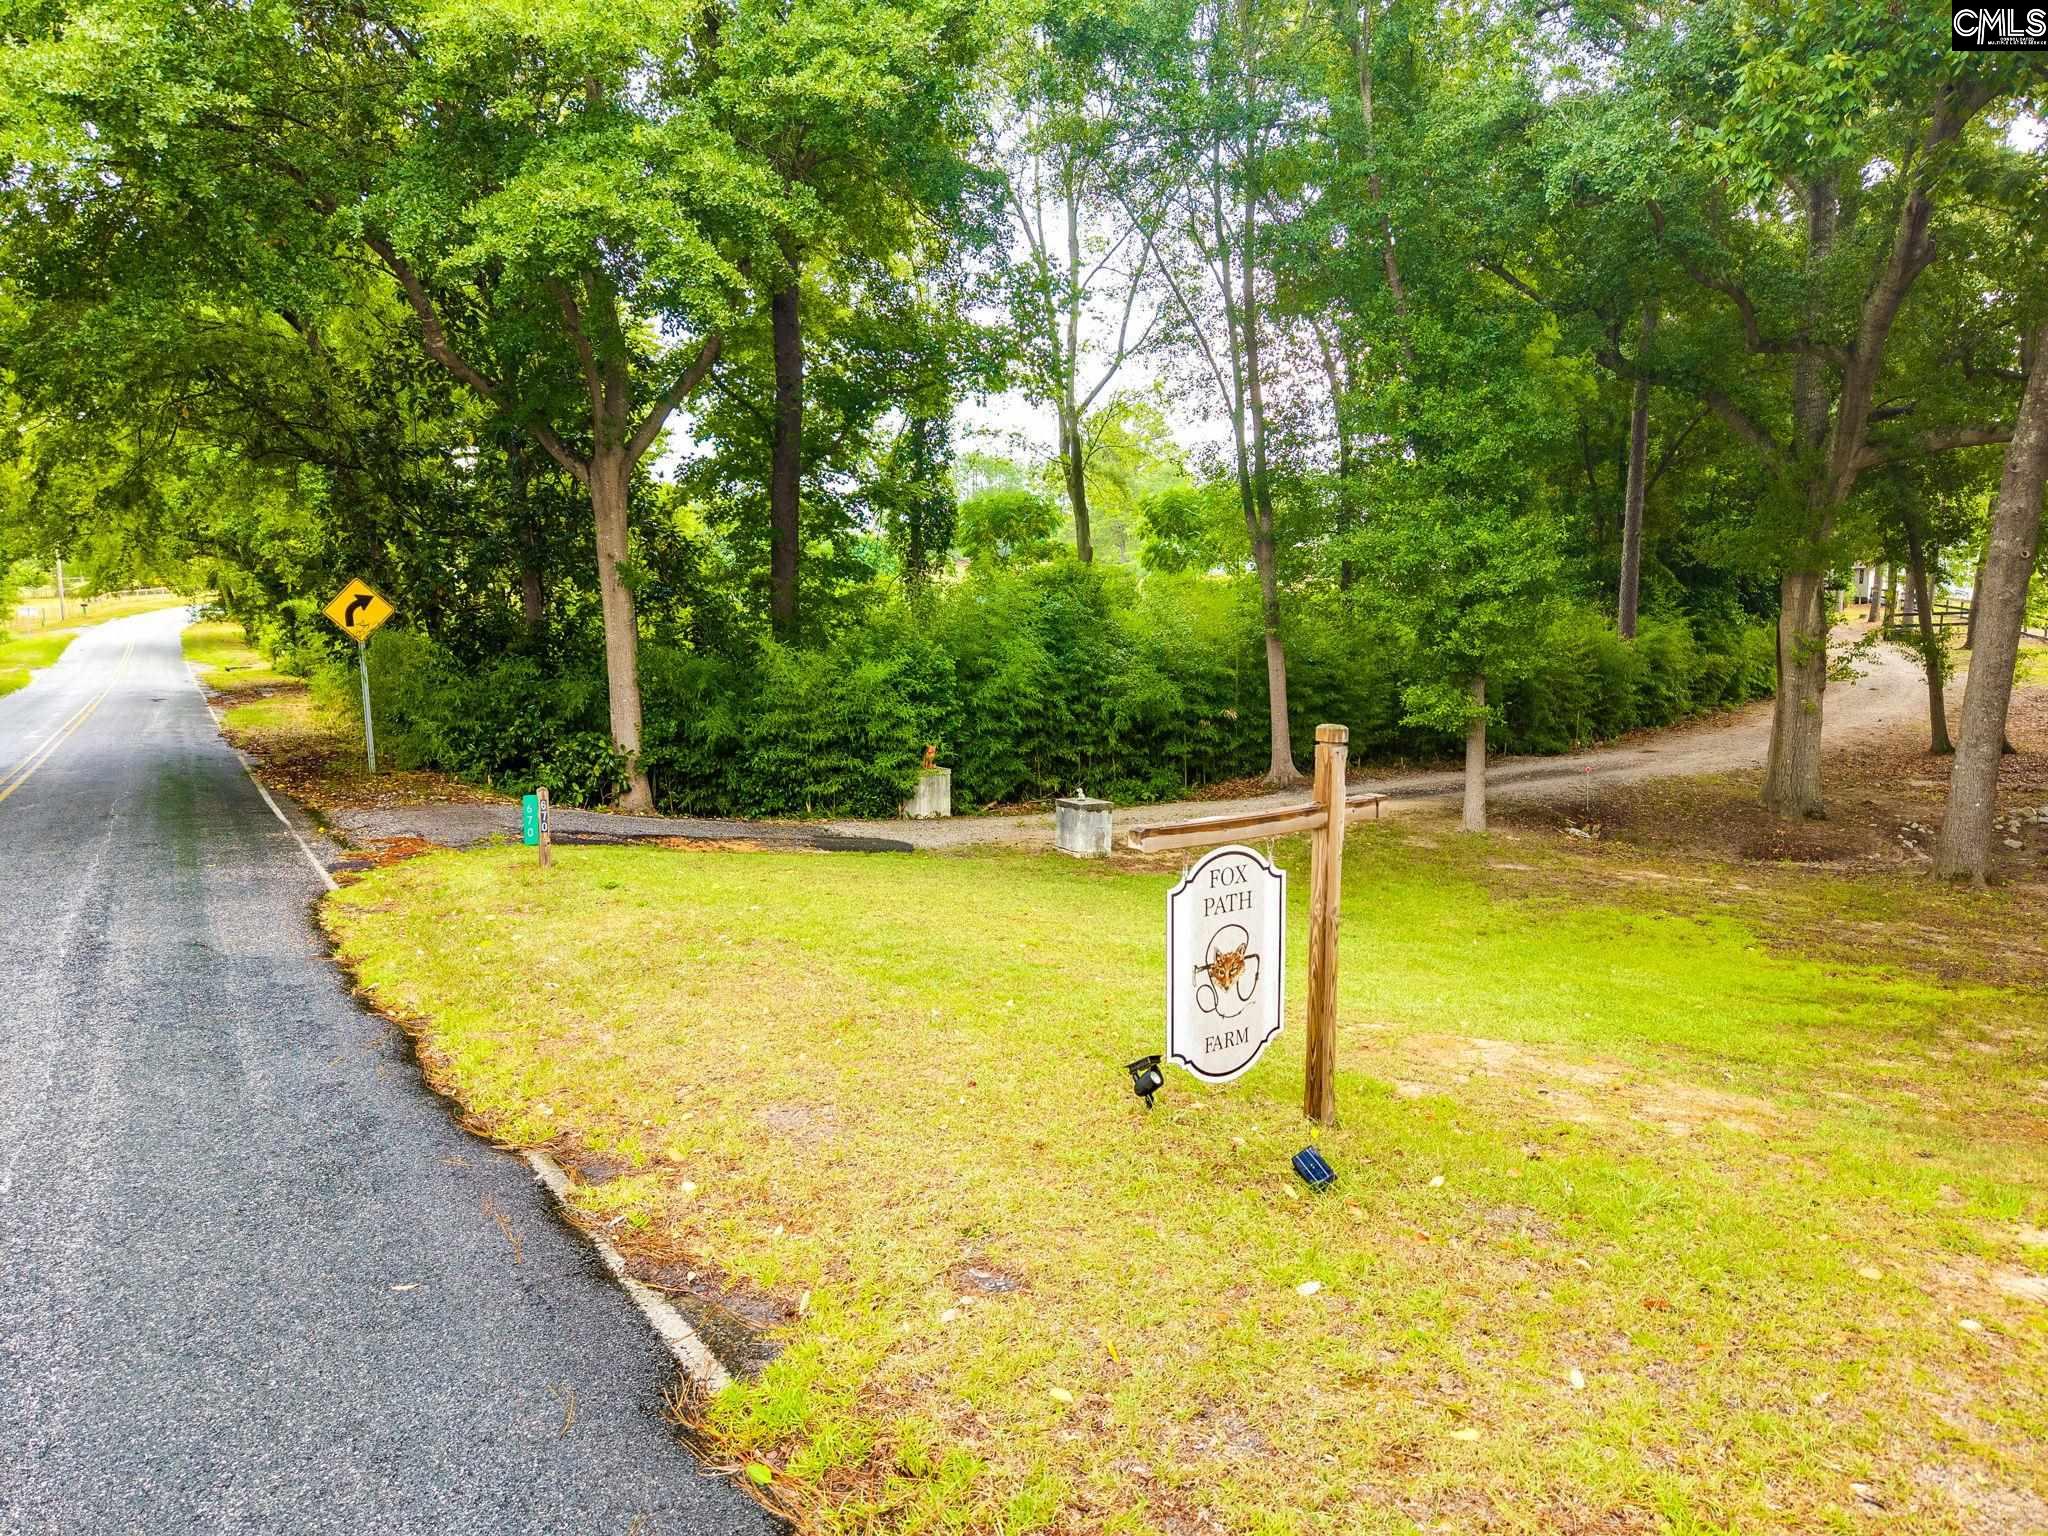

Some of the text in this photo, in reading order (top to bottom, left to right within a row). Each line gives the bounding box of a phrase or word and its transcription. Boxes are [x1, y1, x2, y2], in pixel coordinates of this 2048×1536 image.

[526, 805, 534, 837] 670
[540, 800, 548, 832] 670
[1209, 864, 1248, 889] FOX
[1204, 890, 1253, 917] PATH
[1205, 1027, 1249, 1054] FARM
